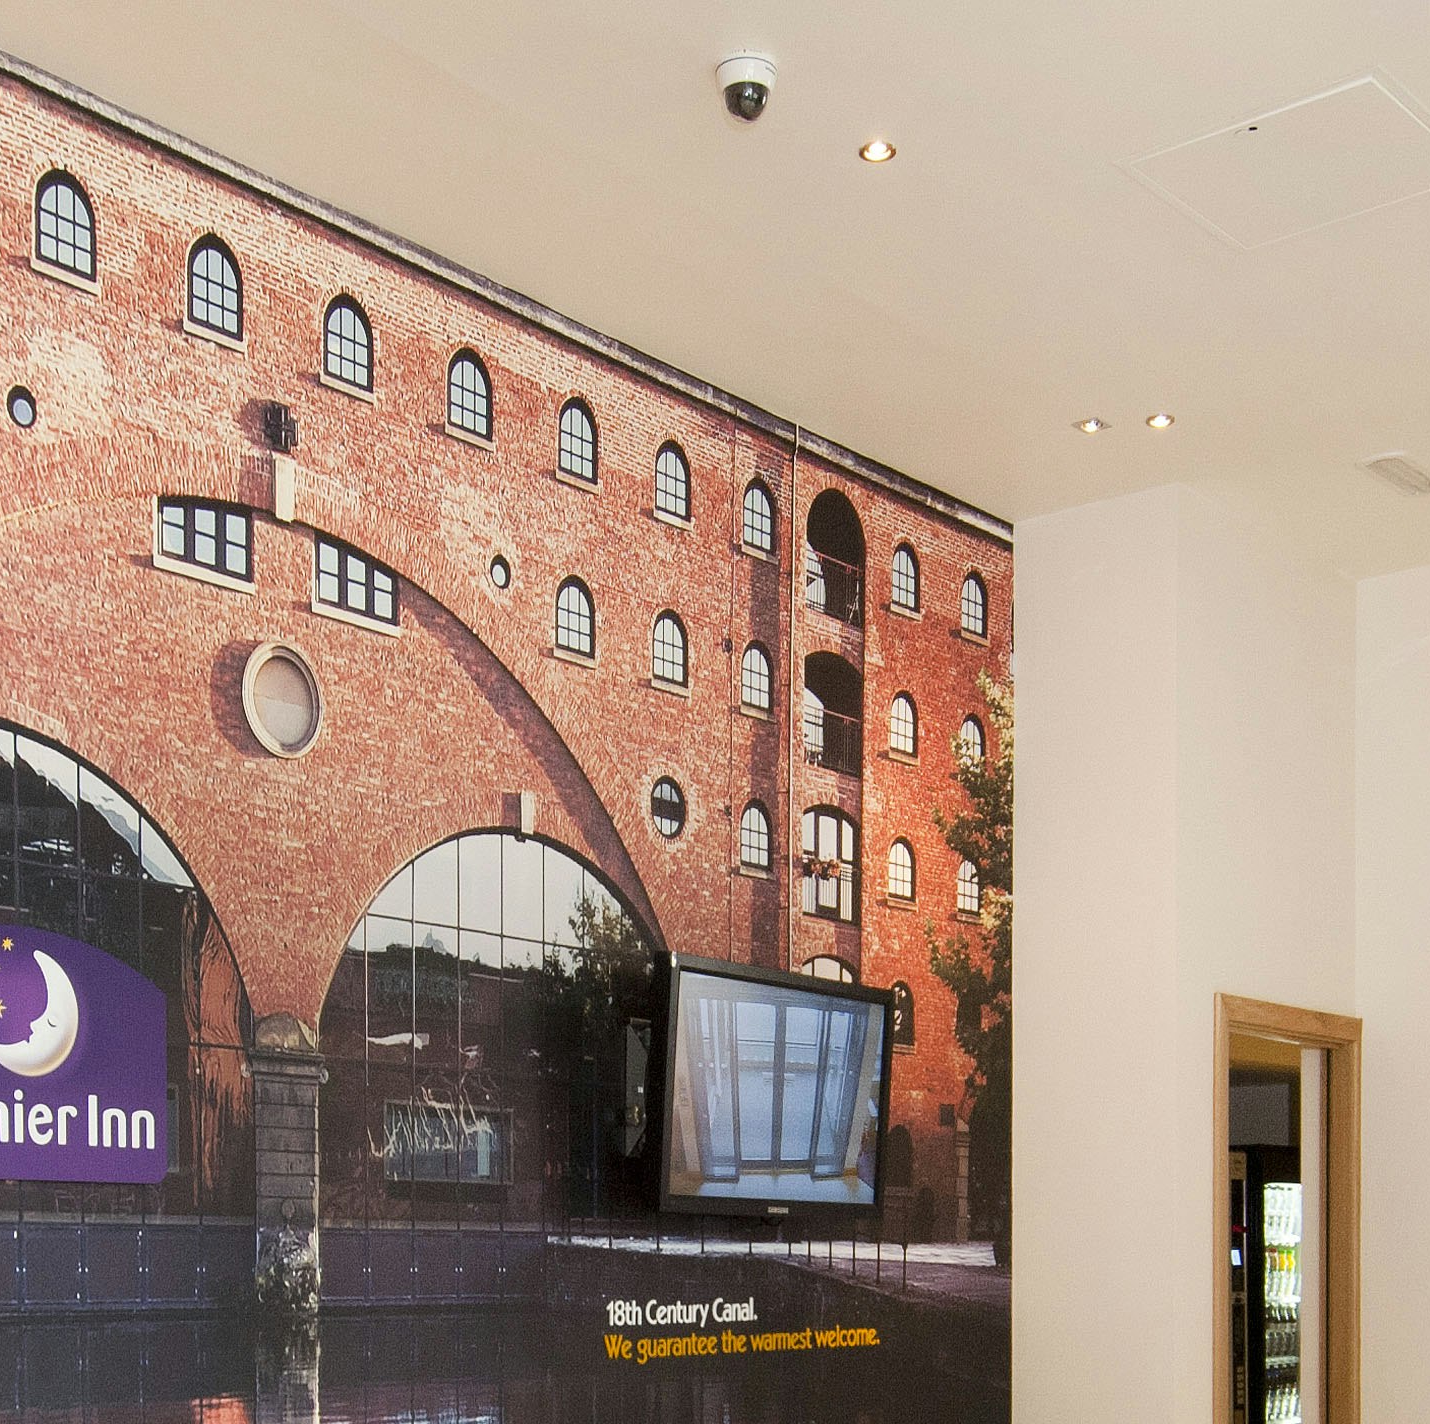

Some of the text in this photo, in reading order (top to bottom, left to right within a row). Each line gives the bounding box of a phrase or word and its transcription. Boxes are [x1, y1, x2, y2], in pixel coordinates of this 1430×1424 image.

[87, 1094, 155, 1149] Inn
[606, 1297, 758, 1328] 18th Century Canal.
[604, 1324, 880, 1365] We guarantee the warmest welcome.
